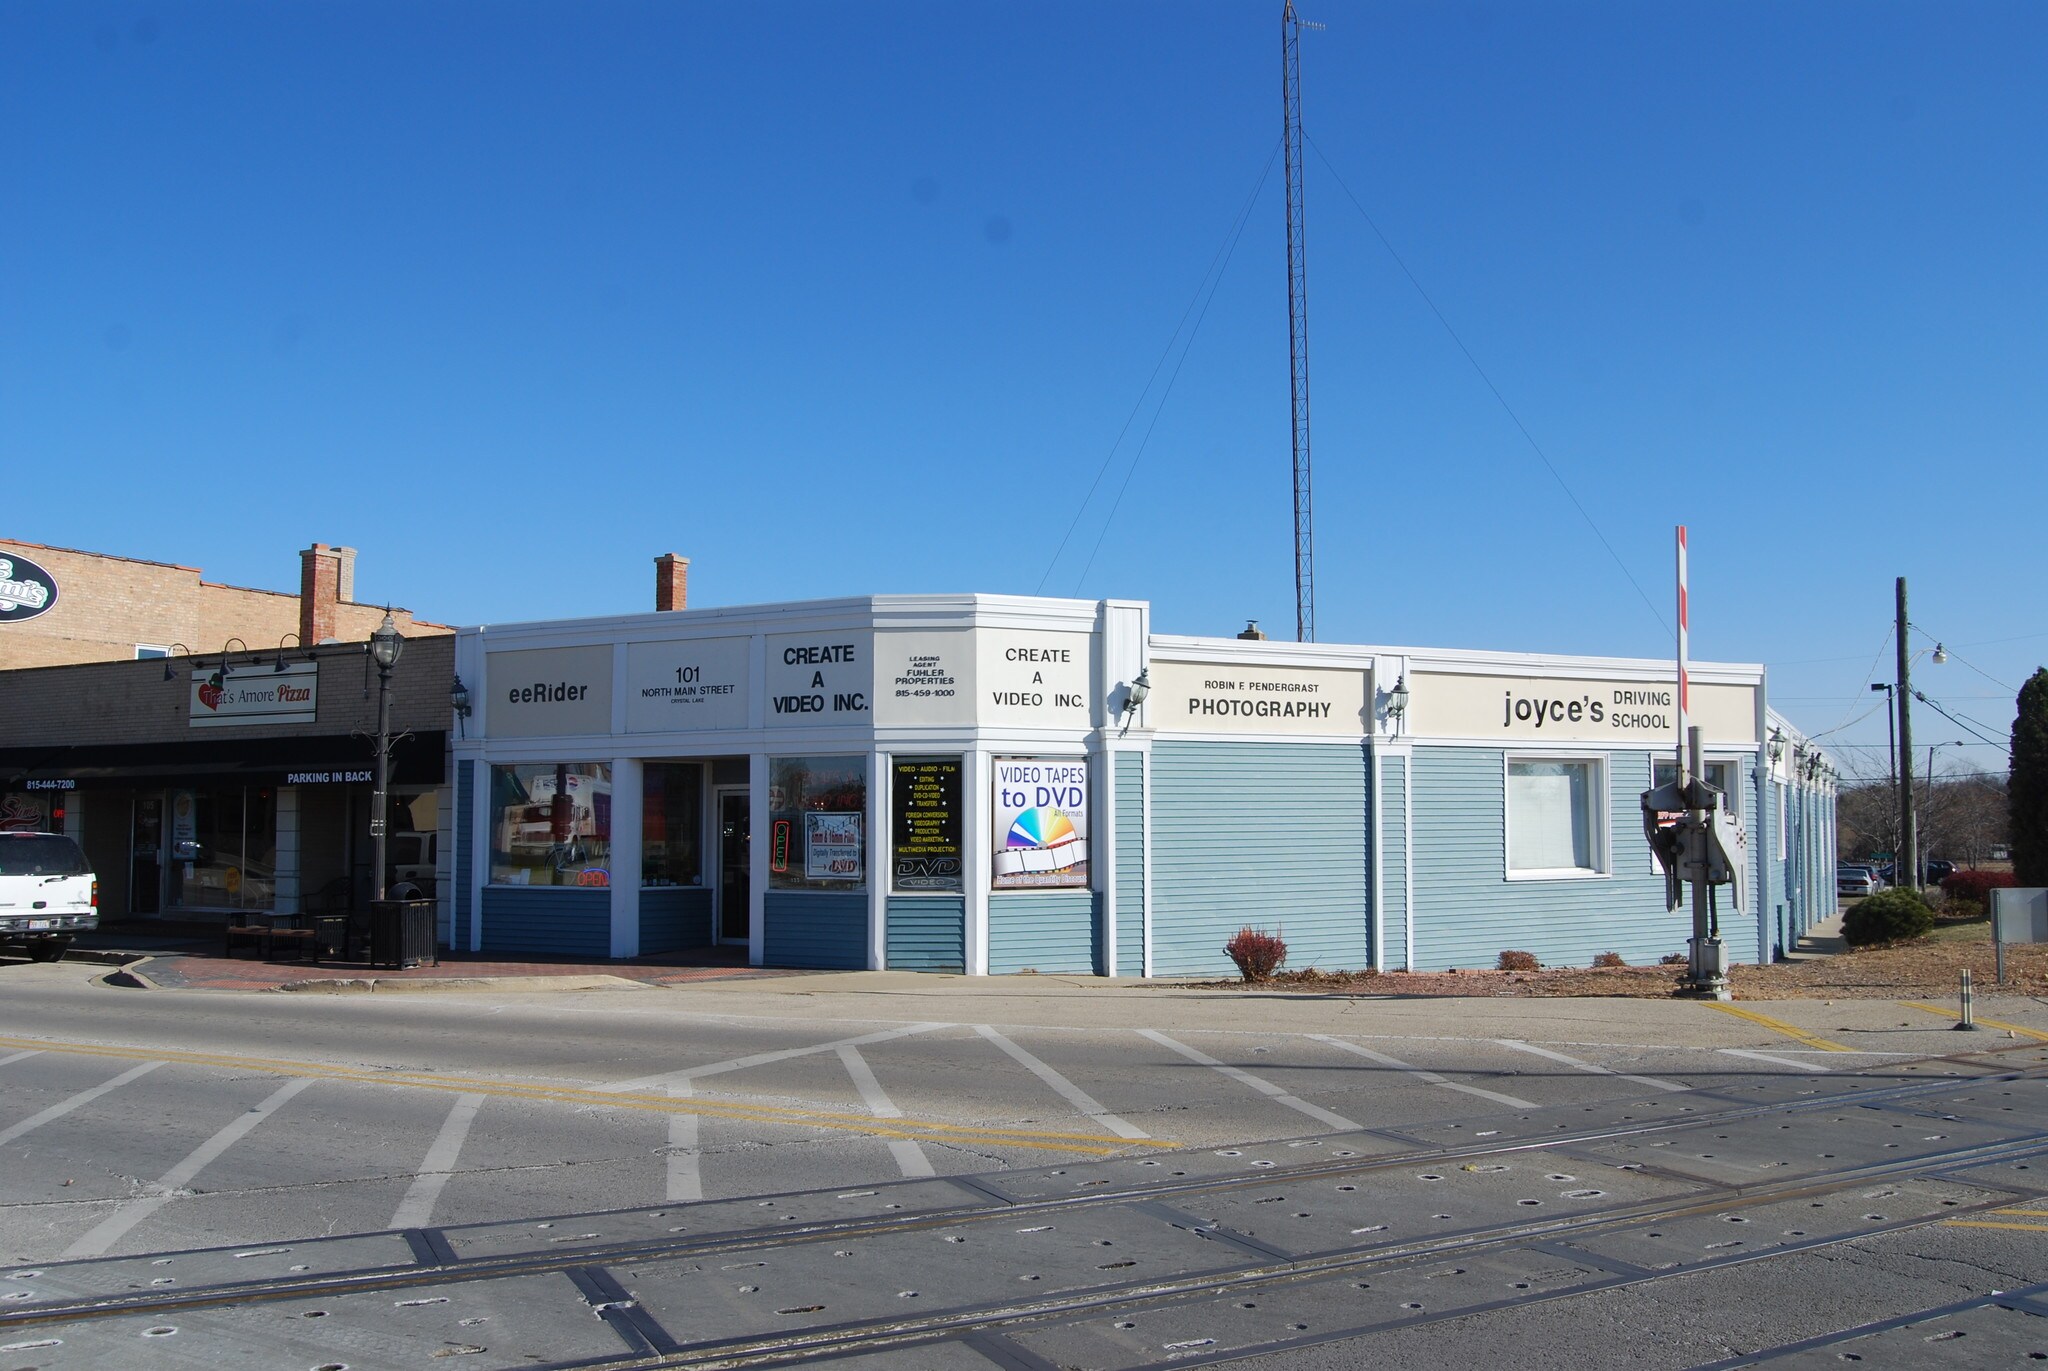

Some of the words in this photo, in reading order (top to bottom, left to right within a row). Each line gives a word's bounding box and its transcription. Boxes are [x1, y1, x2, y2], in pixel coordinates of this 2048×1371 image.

[783, 644, 855, 665] CREATE
[1005, 648, 1070, 663] CREATE
[675, 666, 700, 683] 101
[811, 671, 825, 688] A
[906, 669, 945, 677] FUHLER
[1032, 671, 1043, 684] A
[895, 677, 955, 685] PROPERTIES
[1204, 680, 1235, 690] ROBIN
[1239, 682, 1245, 690] F.
[1249, 682, 1319, 693] PENDERGRAST
[203, 688, 235, 705] That's
[238, 689, 275, 703] Amore
[277, 684, 310, 702] Pizza
[509, 682, 588, 704] eeRider
[642, 687, 672, 697] NORTH
[674, 686, 697, 696] MAIN
[700, 684, 735, 695] STREET
[895, 689, 955, 697] 815-459-1000
[1613, 690, 1671, 706] DRIVING
[772, 694, 825, 714] VIDEO
[833, 692, 869, 711] INC.
[992, 692, 1043, 706] VIDEO
[1055, 694, 1084, 707] INC.
[1189, 698, 1331, 718] PHOTOGRAPHY
[1504, 691, 1604, 728] joyce's
[1612, 713, 1670, 729] SCHOOL
[287, 772, 330, 784] PARKING
[332, 772, 343, 782] IN
[345, 771, 372, 782] BACK
[1000, 767, 1041, 783] VIDEO
[1044, 767, 1084, 783] TAPES
[26, 779, 75, 790] 815-444-7200
[1001, 788, 1026, 807] to
[1036, 786, 1083, 808] DVD
[1062, 809, 1084, 817] Formats
[776, 824, 786, 869] OPEN
[812, 848, 829, 859] Digitally
[829, 848, 852, 857] Transferred
[829, 860, 857, 873] DVD
[898, 857, 961, 877] DVD
[577, 871, 609, 886] OPEN
[996, 875, 1015, 885] Home
[1023, 875, 1034, 884] the
[1035, 874, 1060, 885] Quantity
[1061, 874, 1087, 884] Discount
